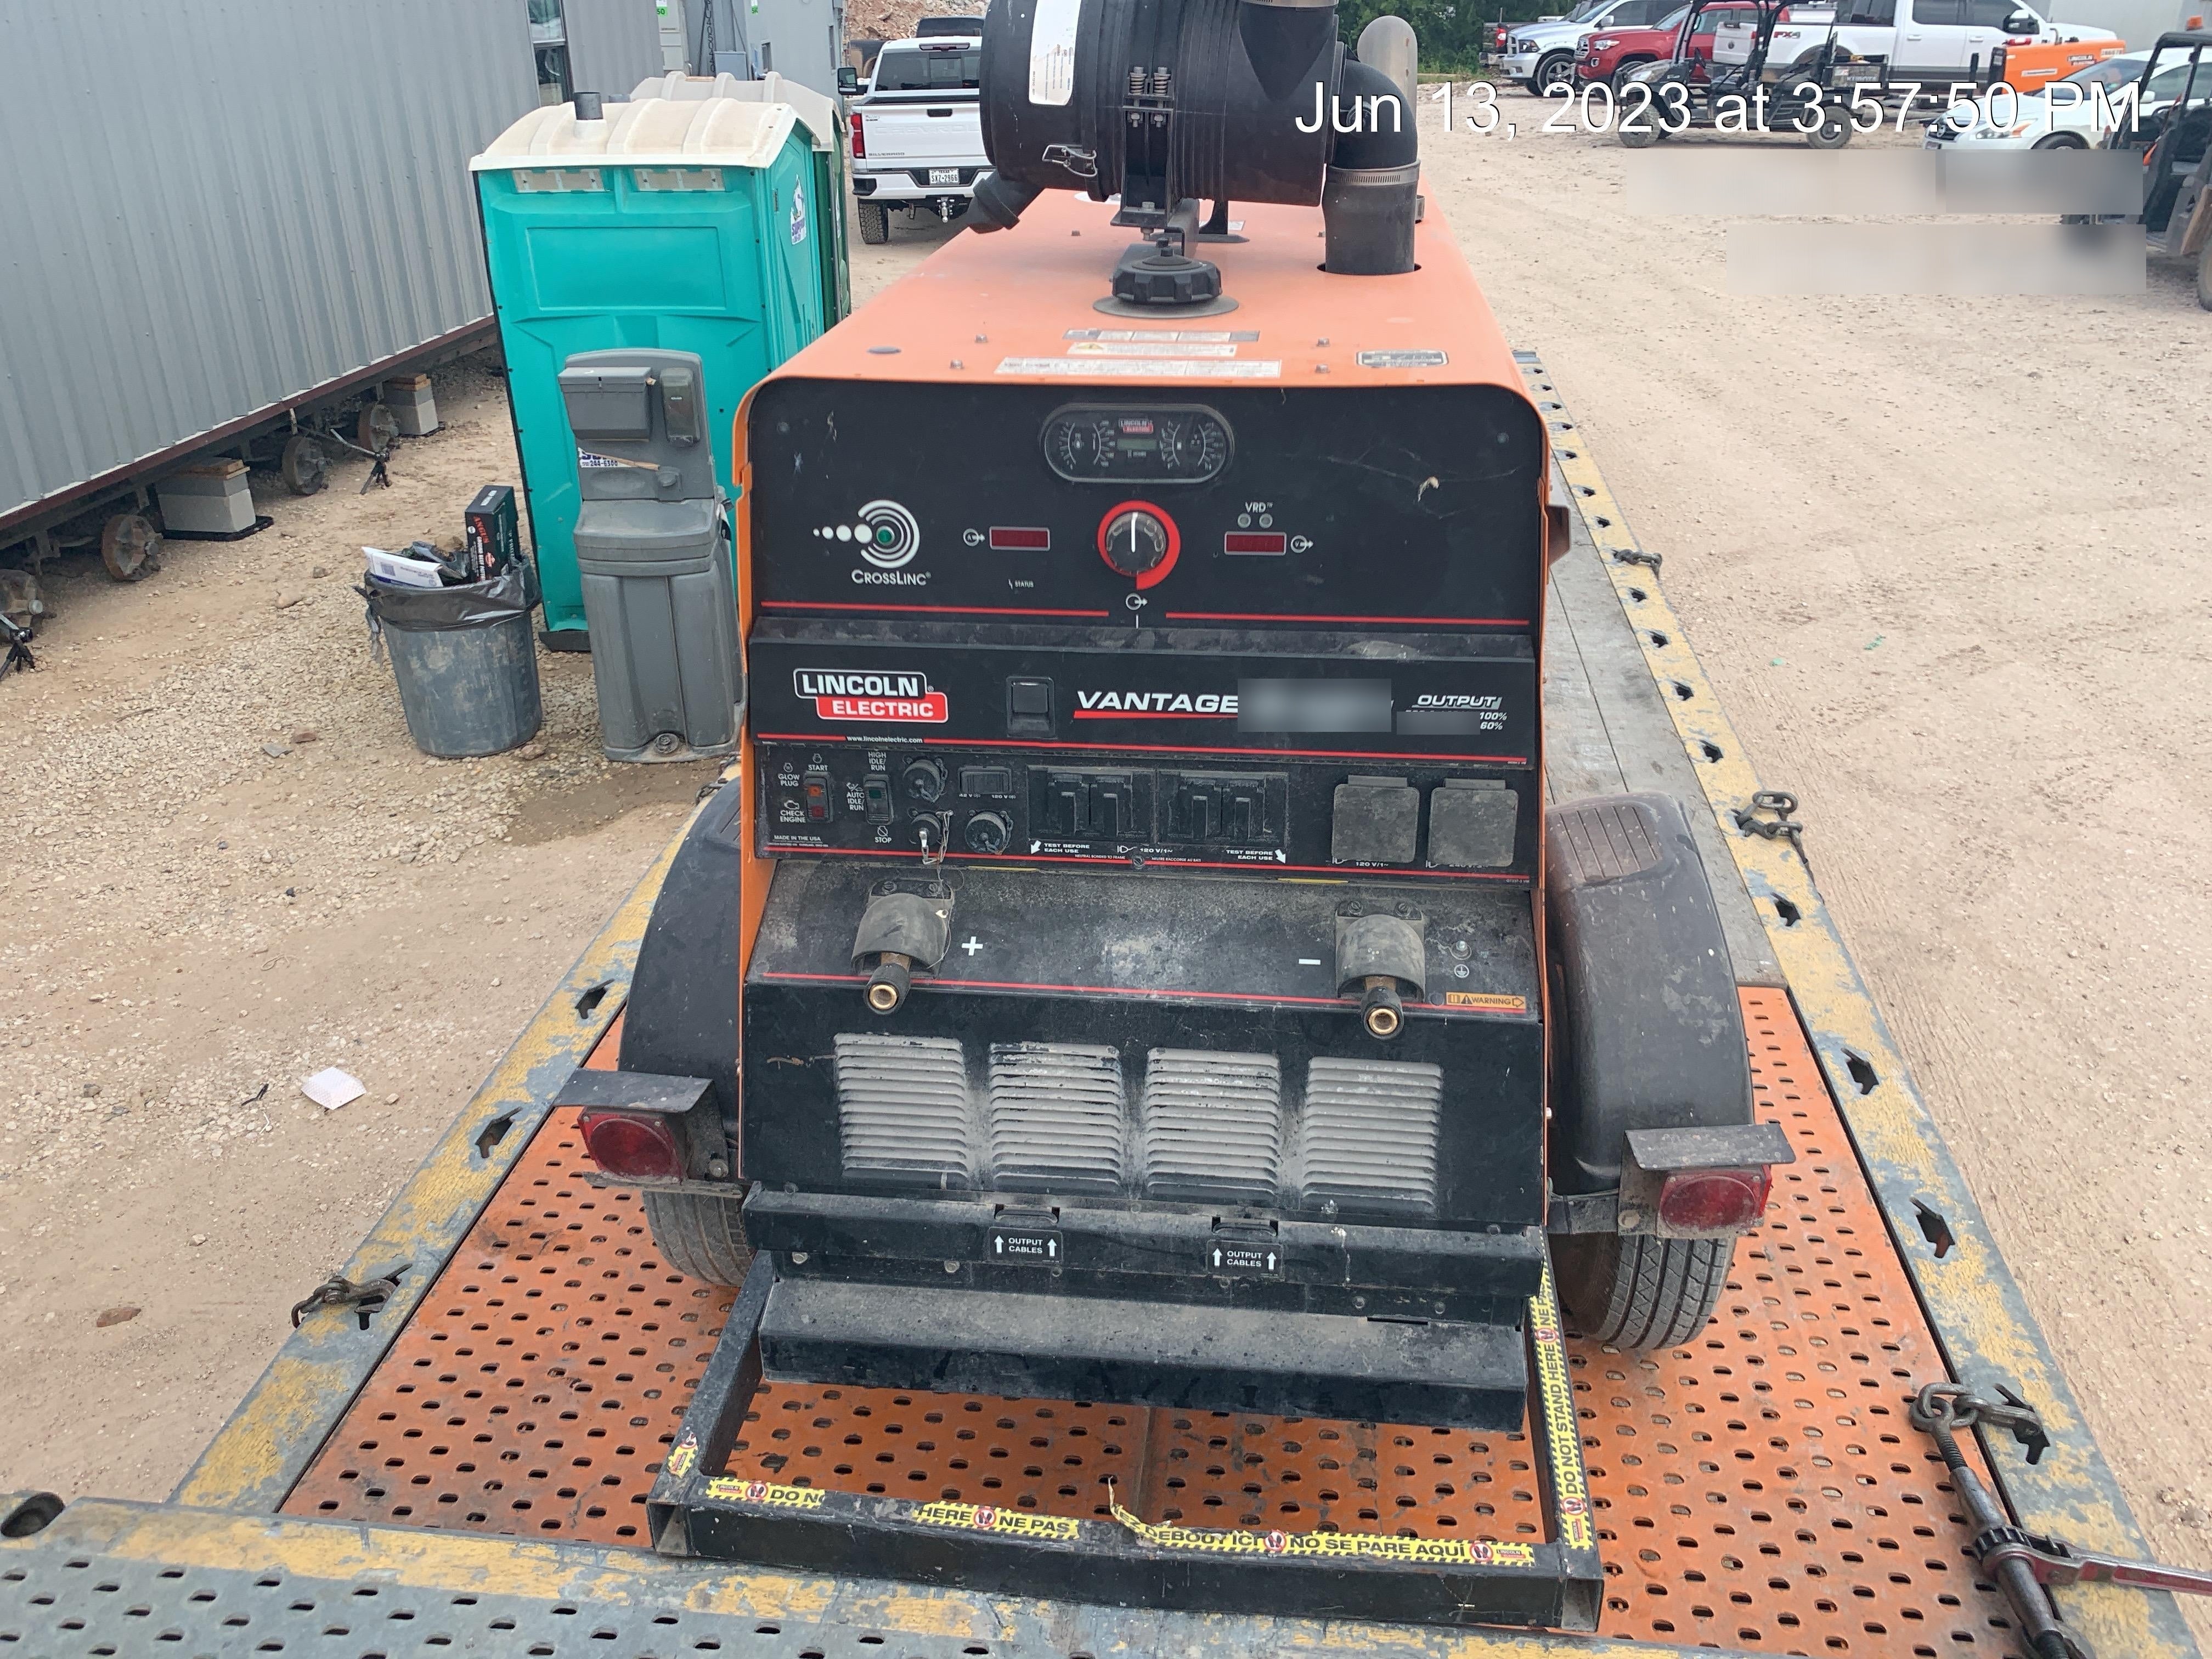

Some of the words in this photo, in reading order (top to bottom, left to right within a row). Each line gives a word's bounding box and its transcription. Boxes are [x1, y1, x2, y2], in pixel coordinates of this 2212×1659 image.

[802, 674, 919, 697] LINCOLN
[832, 700, 934, 718] ELECTRIC
[1077, 690, 1238, 713] VANTAGE
[1417, 695, 1497, 708] OUTPUT
[1480, 712, 1508, 721] 100%
[1480, 721, 1503, 731] 60%
[847, 735, 923, 743] www.lincolnelectric.com
[1471, 996, 1511, 1005] WARNING
[1008, 1237, 1043, 1246] OUTPUT
[1008, 1245, 1043, 1254] CABLES
[1227, 1250, 1263, 1259] OUTPUT
[1227, 1258, 1262, 1267] CABLES
[1538, 1308, 1551, 1326] NE
[1544, 1344, 1560, 1381] HERE
[1550, 1384, 1568, 1433] STAND
[1557, 1434, 1574, 1468] NOT
[1563, 1470, 1578, 1494] DO
[770, 1489, 800, 1501] DO
[918, 1506, 971, 1521] HERE
[998, 1516, 1027, 1528] NE
[1030, 1519, 1070, 1533] PAS
[1290, 1537, 1320, 1548] NO
[1325, 1538, 1352, 1550] SE
[1357, 1541, 1412, 1554] PARE
[1415, 1543, 1465, 1557] AQUÍ
